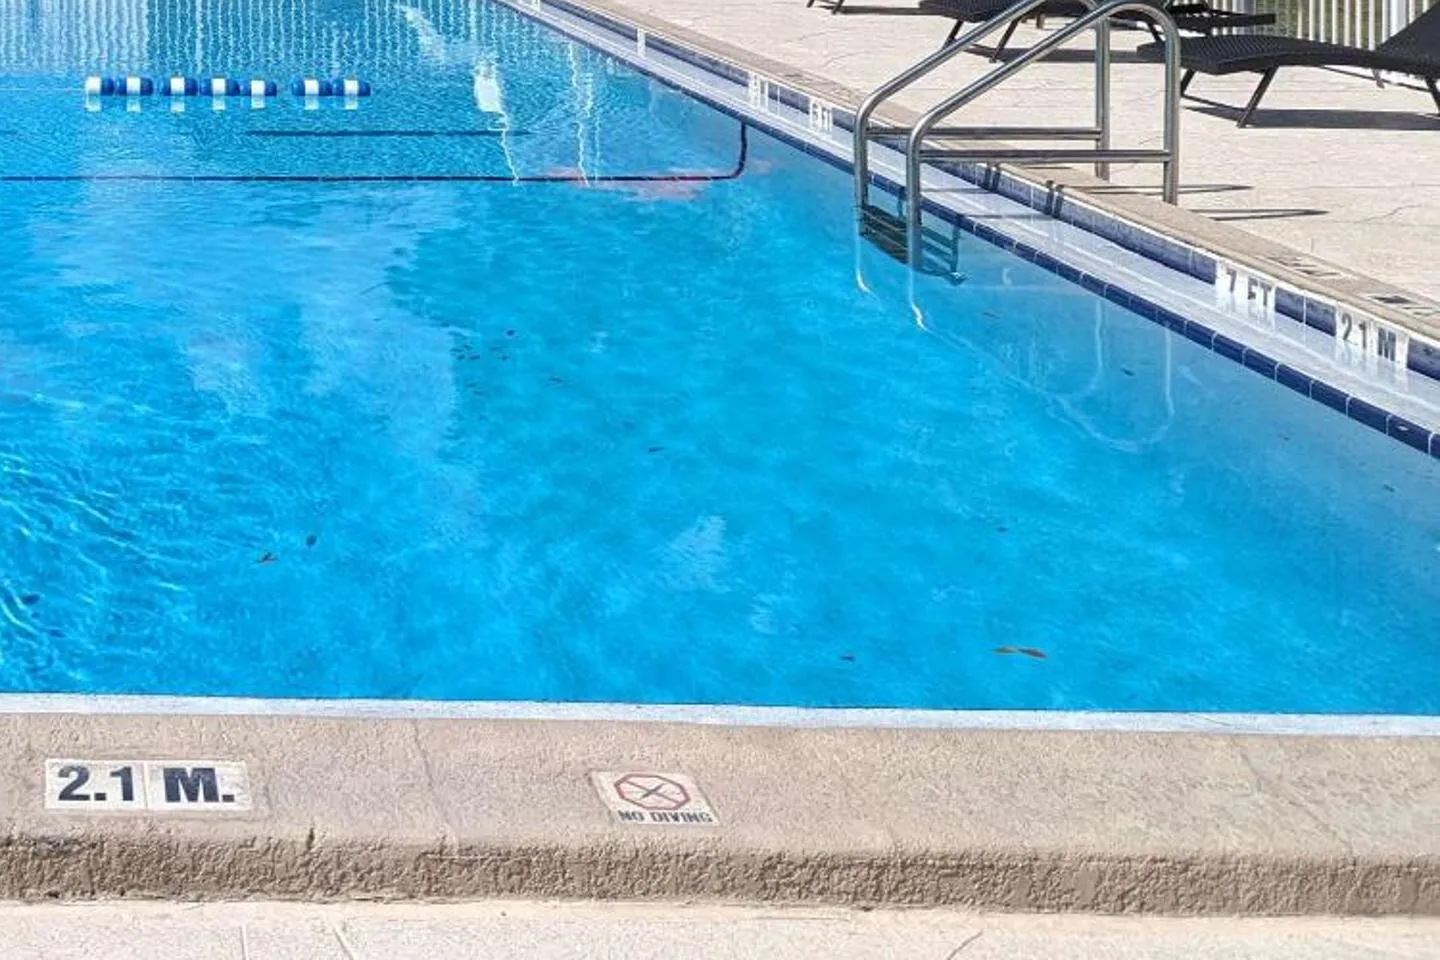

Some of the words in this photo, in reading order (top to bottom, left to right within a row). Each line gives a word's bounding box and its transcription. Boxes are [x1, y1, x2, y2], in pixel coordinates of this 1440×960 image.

[1226, 267, 1237, 293] 7
[1248, 275, 1272, 307] FT
[1378, 327, 1397, 361] M
[57, 765, 134, 801] 2.1
[162, 767, 235, 803] M.
[617, 810, 645, 821] NO
[649, 811, 713, 822] DIVING
